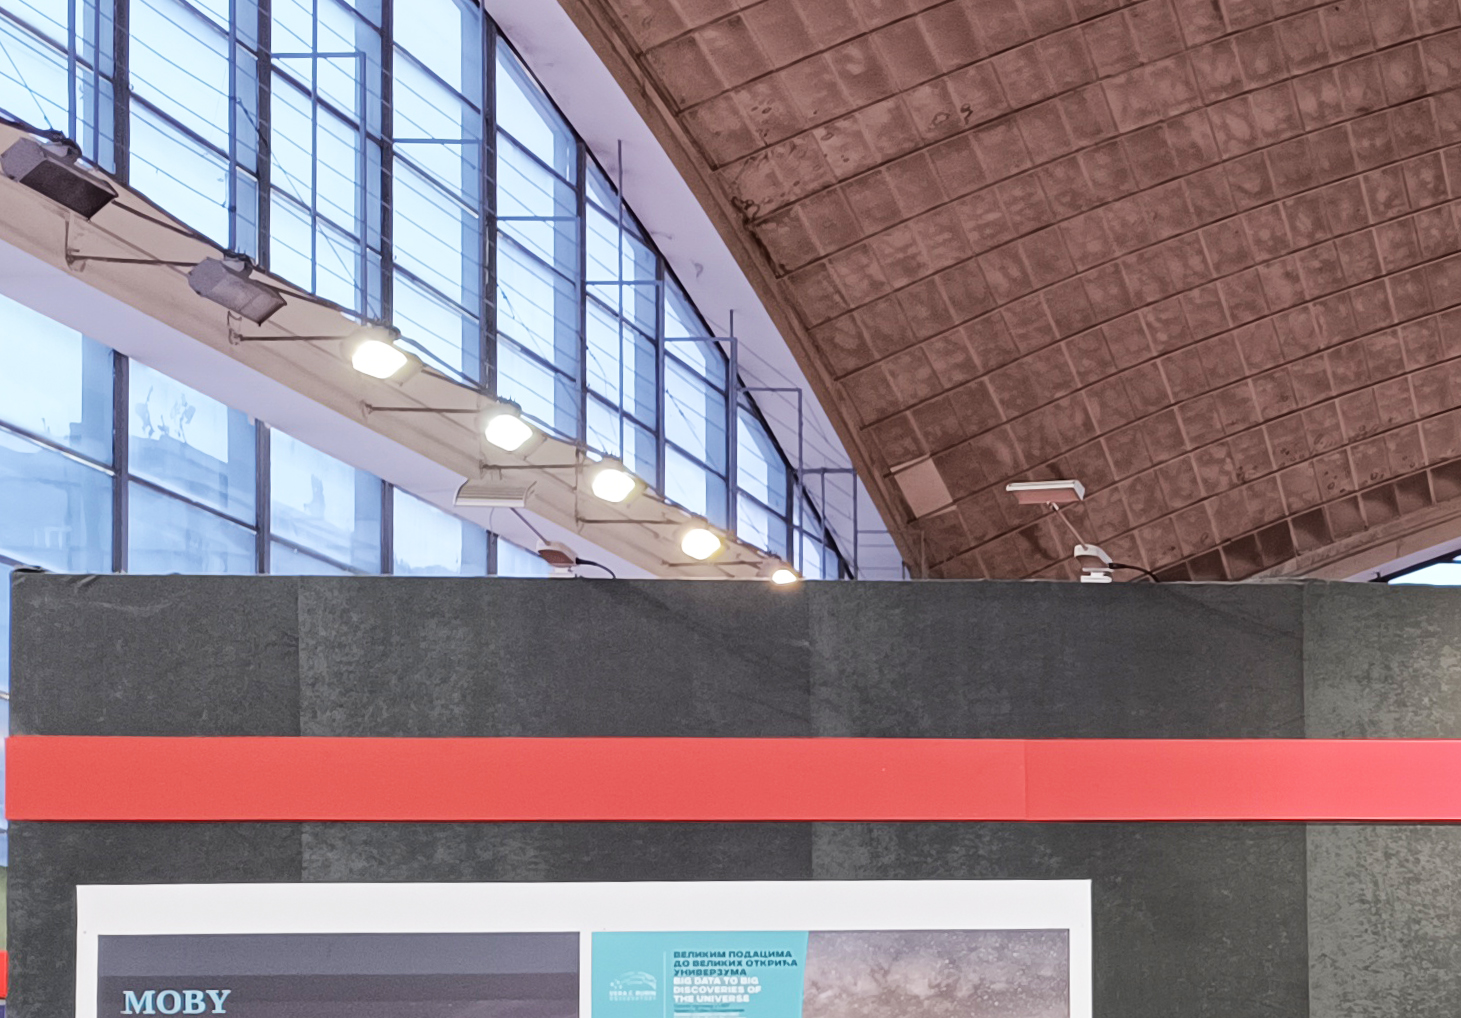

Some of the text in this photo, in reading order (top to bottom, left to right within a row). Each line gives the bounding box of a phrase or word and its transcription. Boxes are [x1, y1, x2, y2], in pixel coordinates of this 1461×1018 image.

[673, 950, 792, 959] ВЕЛИКИМ ПОДАЦИМА
[673, 959, 798, 968] ДО ВЕЛИКИХ ОТКРИЋА
[673, 968, 747, 976] УНИВЕРЗУМА
[673, 977, 759, 985] BIG DATA TO BIG
[673, 985, 762, 994] DISCOVERIES OF
[120, 989, 231, 1015] MOBY
[673, 994, 750, 1003] THE UNIVERSE
